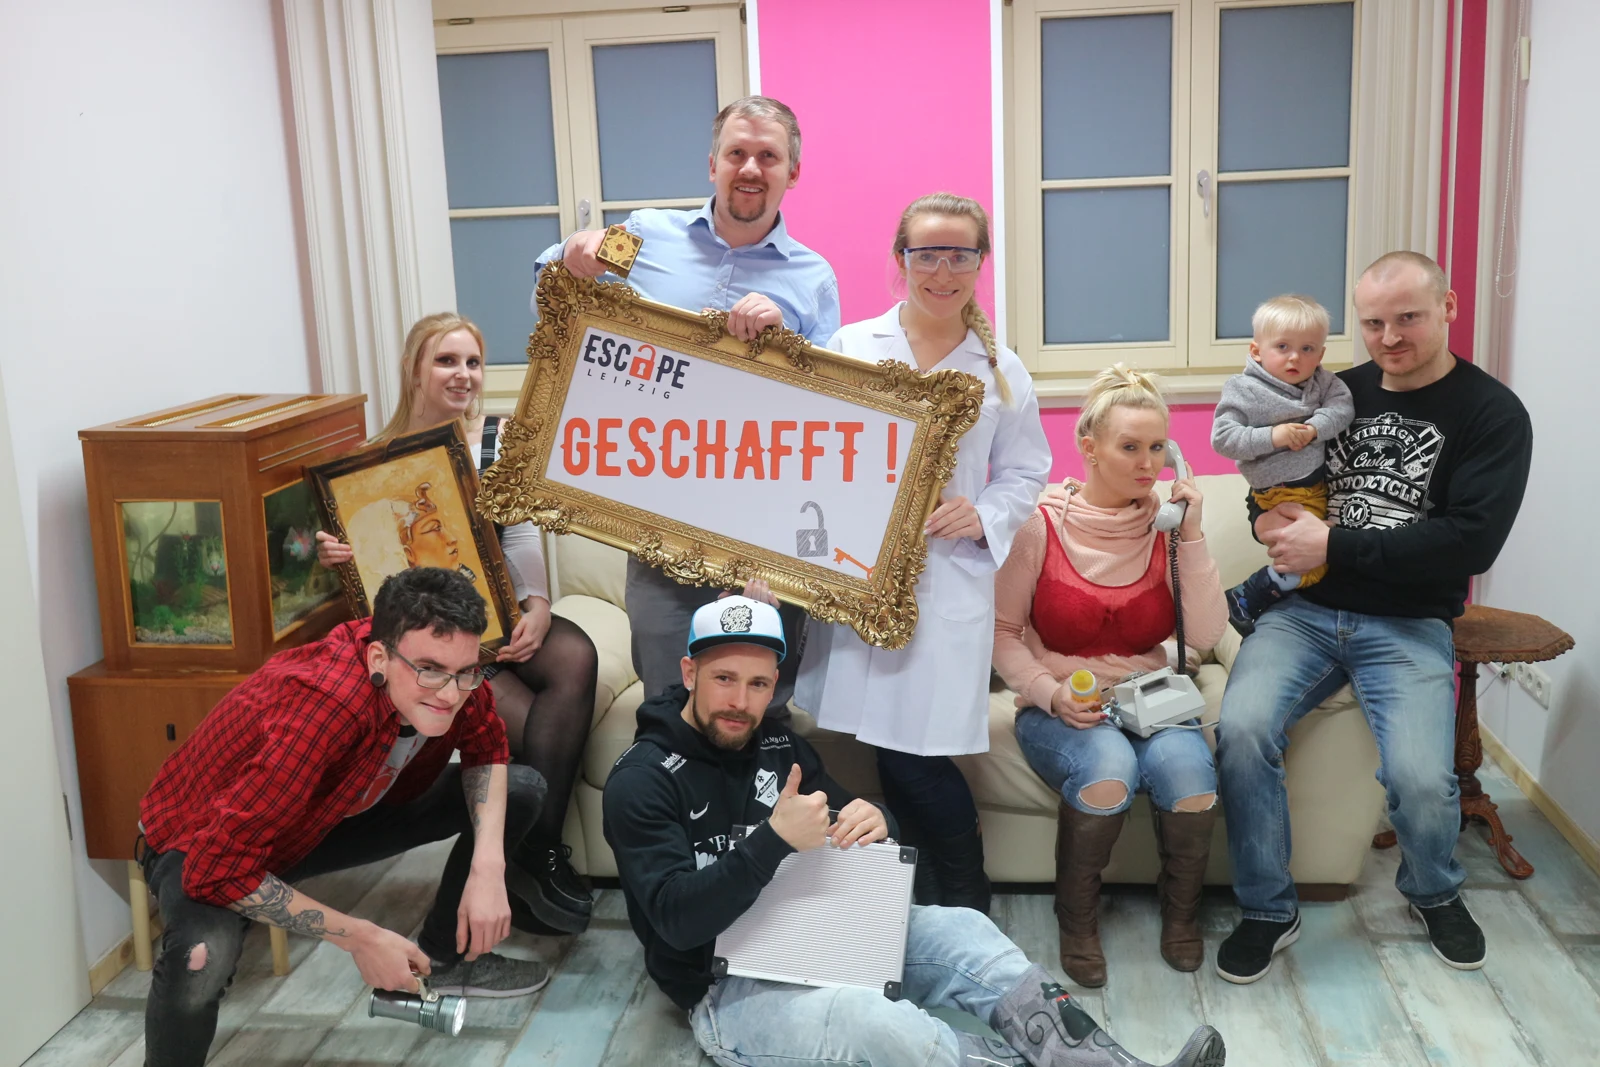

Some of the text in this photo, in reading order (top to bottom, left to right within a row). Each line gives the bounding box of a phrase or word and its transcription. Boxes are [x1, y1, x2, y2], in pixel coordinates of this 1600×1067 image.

[587, 368, 671, 399] LEIPZIG
[560, 417, 864, 482] GESCHAFFT
[1352, 425, 1415, 446] VINTAGE
